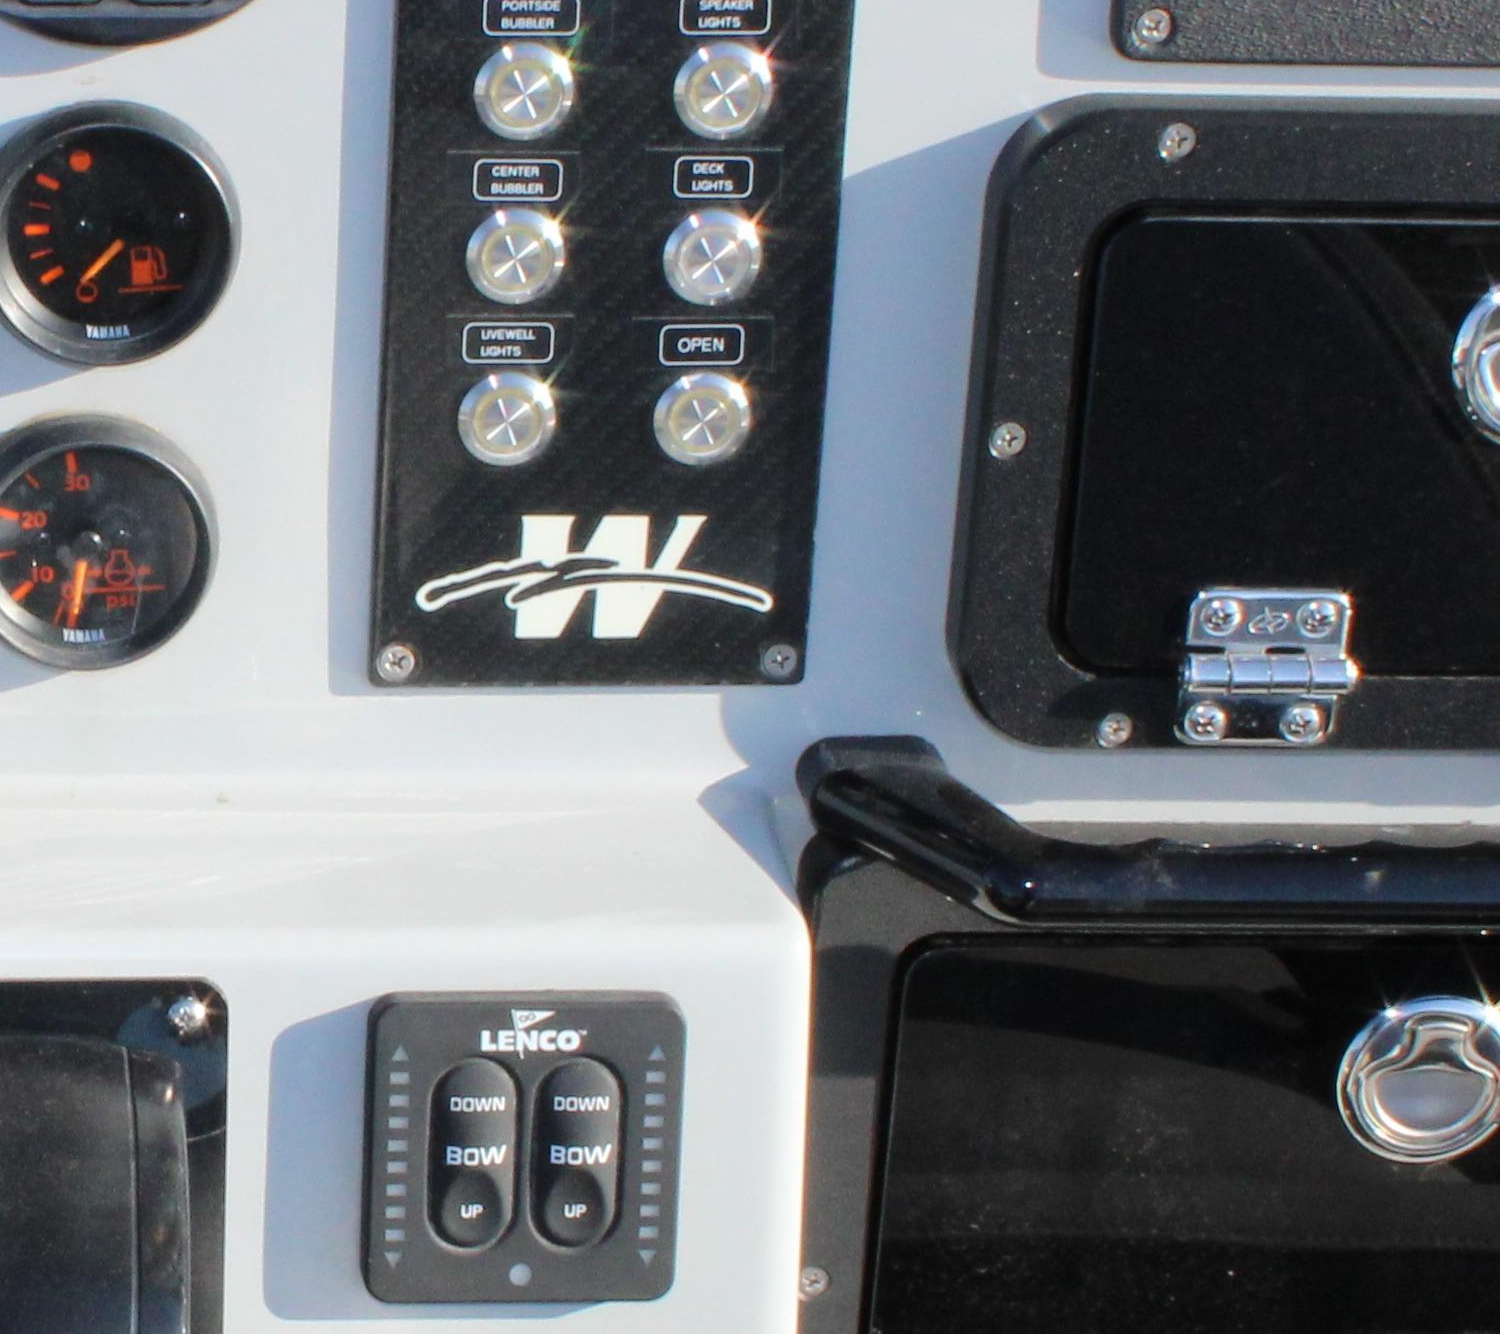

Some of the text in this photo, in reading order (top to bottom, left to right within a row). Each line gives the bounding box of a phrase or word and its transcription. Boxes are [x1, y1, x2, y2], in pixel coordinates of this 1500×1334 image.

[501, 0, 560, 11] PORTSIDE
[501, 17, 554, 29] BUBBLER
[698, 17, 741, 28] LIGHTS
[491, 165, 540, 178] CENTER
[692, 163, 725, 175] DECK
[490, 182, 544, 195] BUBBLER
[692, 179, 733, 192] LIGHTS
[86, 325, 130, 338] YAMAHA
[480, 328, 536, 341] LIVEWELL
[480, 345, 522, 358] LIGHTS
[677, 337, 725, 354] OPEN
[64, 475, 90, 492] 30
[21, 511, 46, 529] 20
[32, 567, 55, 583] 10
[62, 628, 106, 643] YAMAHA
[450, 1096, 505, 1112] DOWN
[554, 1096, 609, 1112] DOWN
[446, 1145, 506, 1165] BOW
[550, 1145, 612, 1165] BOW
[461, 1204, 484, 1218] UP
[563, 1204, 587, 1218] UP
